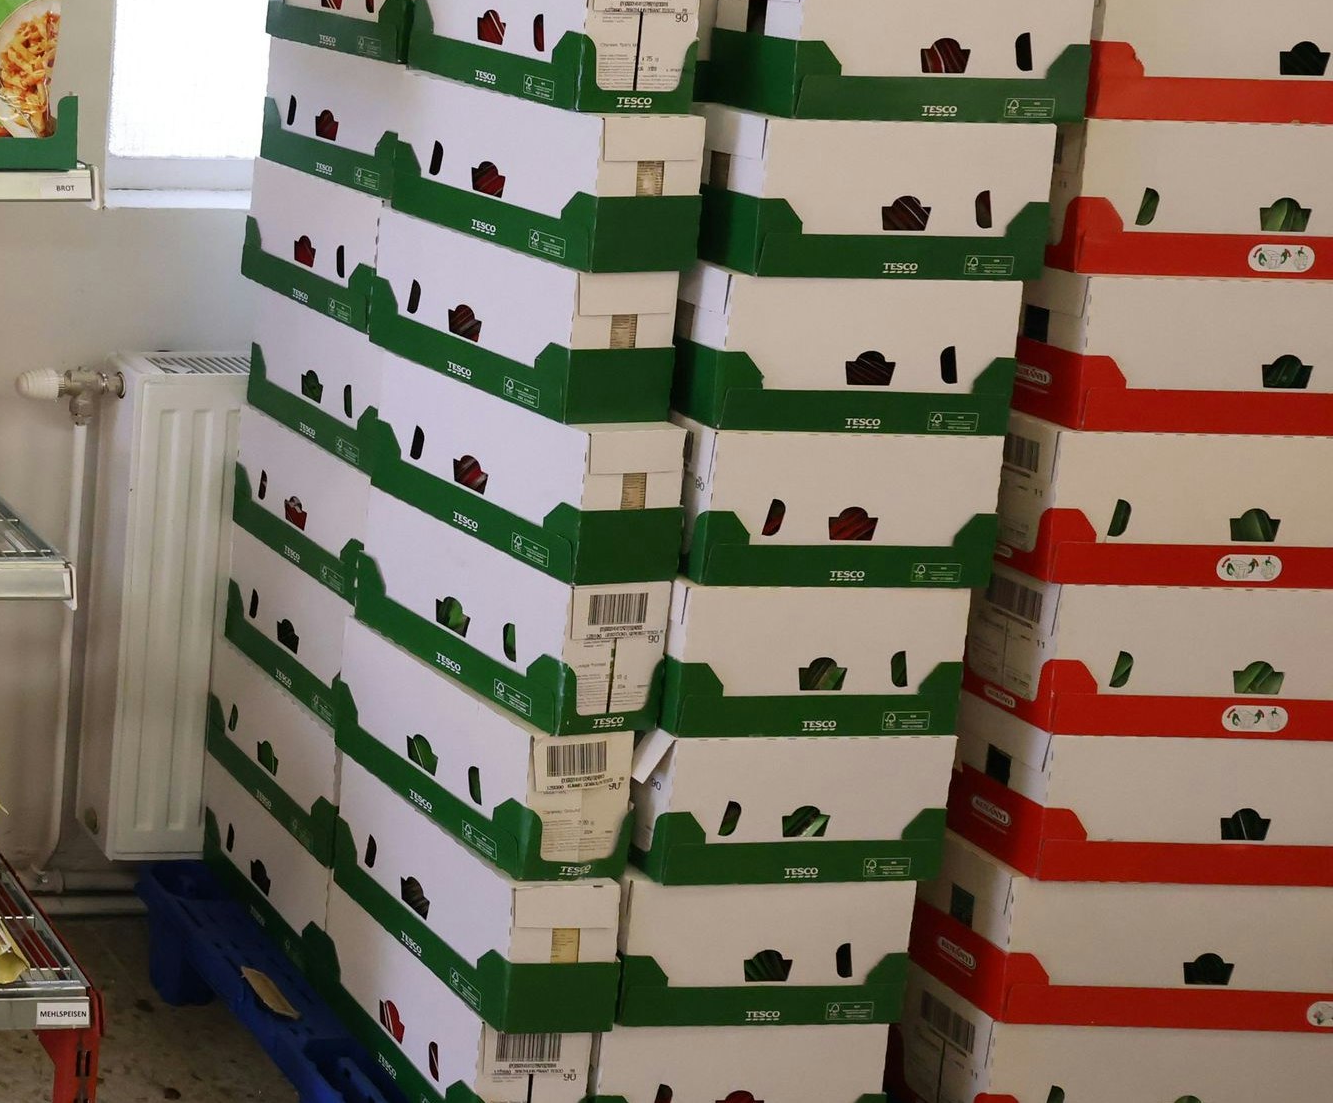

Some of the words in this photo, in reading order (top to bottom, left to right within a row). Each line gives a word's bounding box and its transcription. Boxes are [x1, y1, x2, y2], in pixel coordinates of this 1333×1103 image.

[675, 13, 689, 23] 90
[475, 70, 496, 82] TESCO
[617, 97, 652, 105] TESCO
[922, 105, 957, 114] TESCO
[471, 219, 496, 233] TESCO
[883, 263, 918, 272] TESCO
[447, 361, 472, 377] TESCO
[845, 418, 881, 427] TESCO
[453, 511, 478, 526] TESCO
[830, 569, 865, 579] TESCO
[648, 635, 660, 644] 90
[594, 717, 624, 725] TESCO
[802, 719, 836, 729] TESCO
[746, 1010, 780, 1019] TESCO
